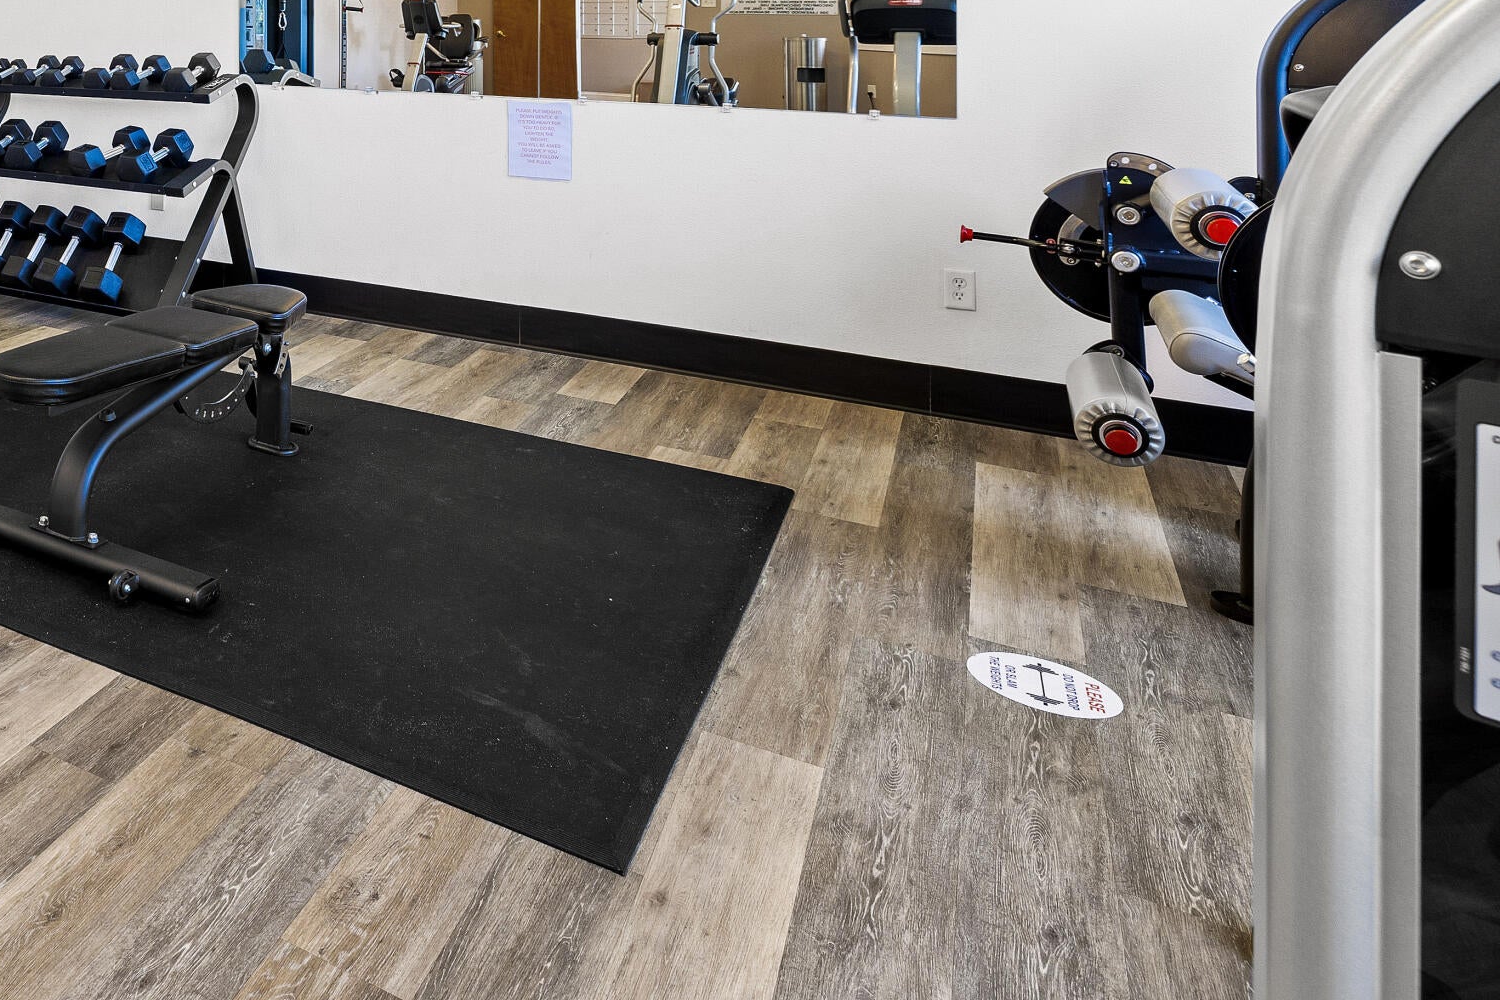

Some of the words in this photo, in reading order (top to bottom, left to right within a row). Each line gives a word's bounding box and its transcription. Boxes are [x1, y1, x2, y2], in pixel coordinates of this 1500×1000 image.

[990, 666, 1002, 690] WEIGHTS
[1006, 672, 1017, 689] SLAM
[1063, 673, 1074, 682] DO
[1064, 682, 1076, 694] NOT
[1067, 695, 1080, 711] DROP
[1085, 683, 1105, 713] PLEASE
